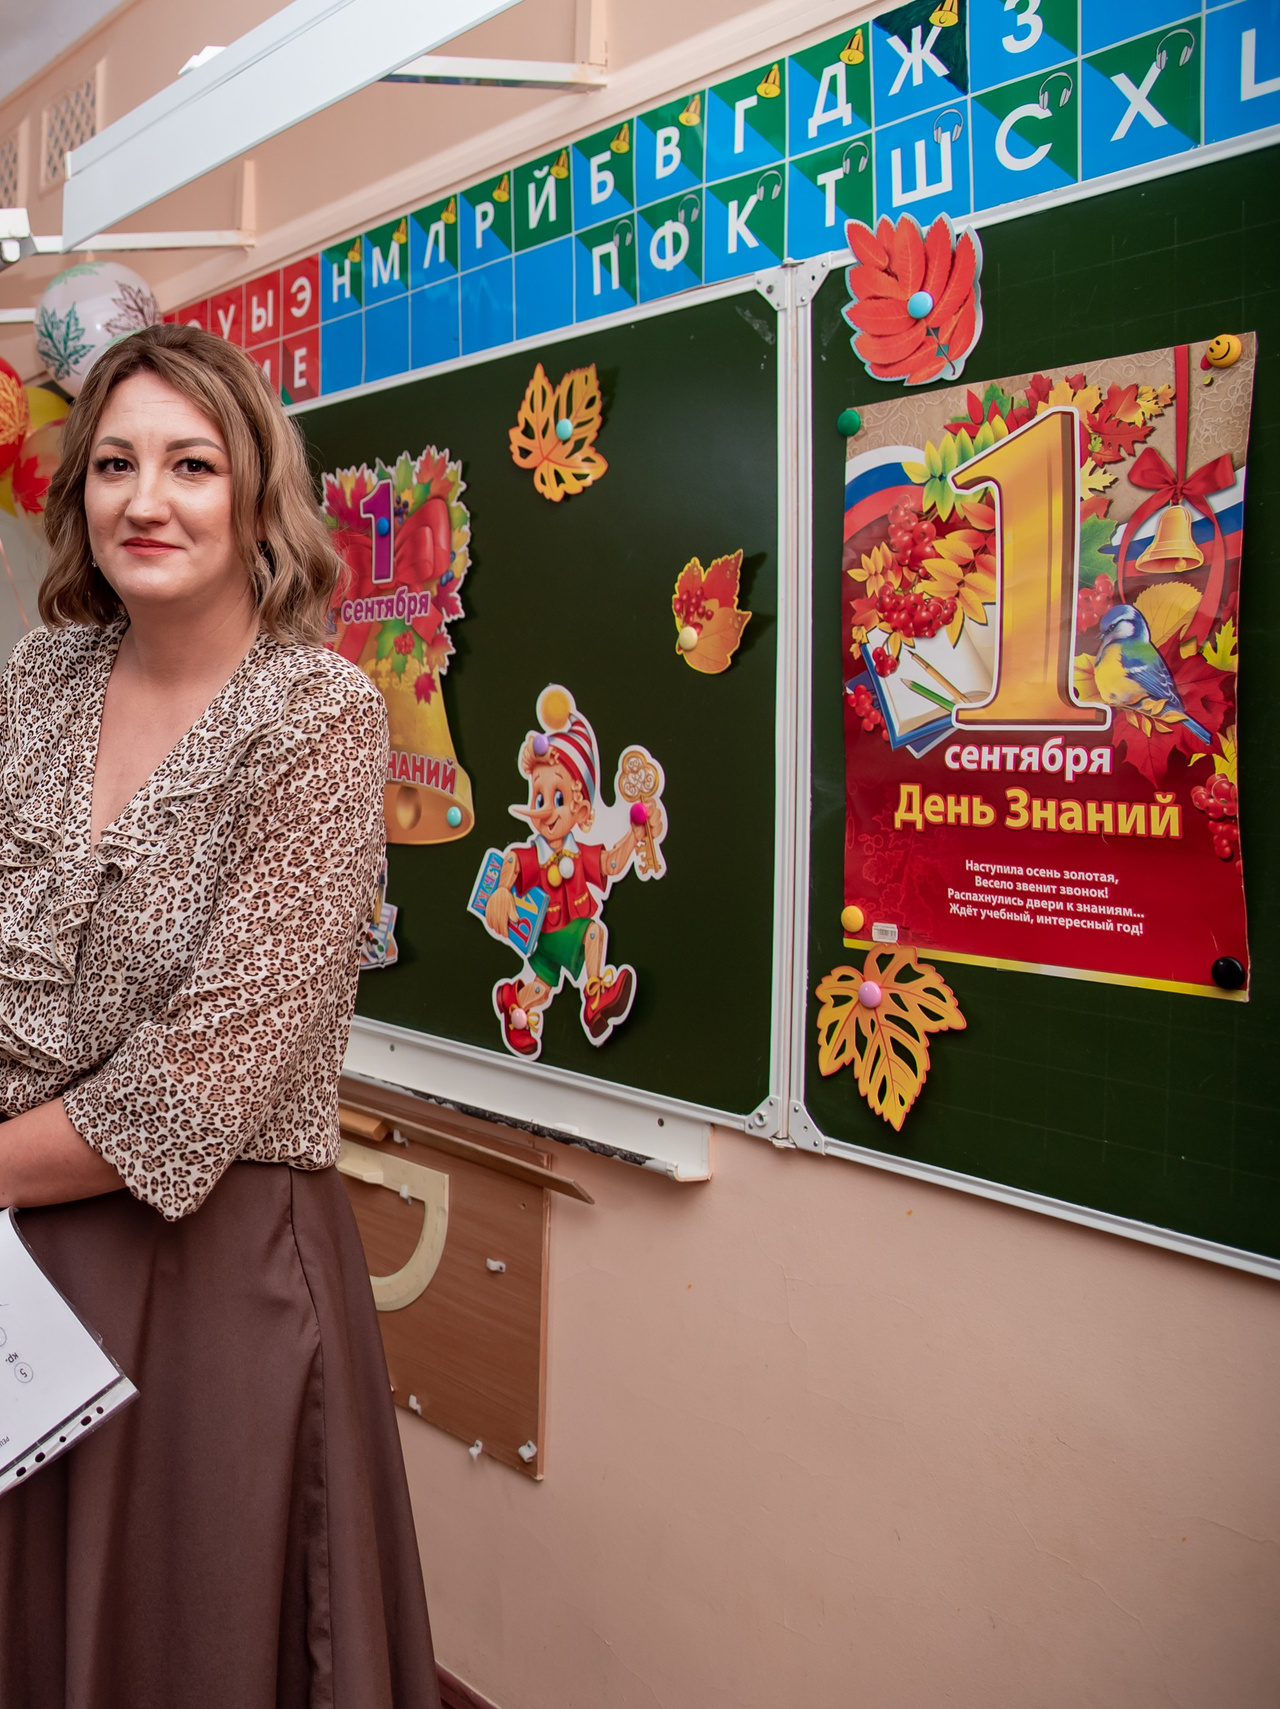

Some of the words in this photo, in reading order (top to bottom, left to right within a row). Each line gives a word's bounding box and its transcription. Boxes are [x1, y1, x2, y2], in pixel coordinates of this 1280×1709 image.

[886, 25, 950, 96] Ж
[734, 94, 758, 154] Г
[808, 61, 852, 139] Д
[1110, 61, 1169, 142] Х
[655, 126, 682, 180] В
[995, 103, 1053, 171] С
[590, 150, 615, 205] Б
[891, 131, 953, 208] Ш
[527, 165, 557, 230] Й
[817, 167, 845, 227] Т
[423, 220, 446, 269] Л
[475, 201, 495, 249] Р
[649, 220, 690, 271] Ф
[728, 194, 760, 254] К
[332, 258, 351, 303] Н
[372, 240, 400, 288] М
[592, 241, 620, 295] П
[251, 289, 274, 333] Ы
[290, 276, 312, 318] Э
[293, 346, 308, 389] Е
[361, 479, 394, 583] 1
[949, 405, 1112, 731] 1
[341, 586, 431, 625] сентября
[384, 750, 456, 795] НАНИЙ
[945, 736, 1113, 782] сентября
[894, 784, 995, 831] День
[1004, 787, 1182, 838] Знаний
[965, 859, 1024, 876] Наступила
[1026, 867, 1061, 879] осень
[1063, 870, 1119, 885] золотая,
[974, 875, 1014, 890] Весело
[1015, 881, 1057, 894] звенит
[1059, 886, 1109, 899] звонок!
[947, 887, 1024, 907] Распахнулись
[1025, 898, 1064, 912] двери
[1066, 901, 1074, 911] к
[949, 902, 979, 917] Ждёт
[979, 908, 1034, 924] учебный,
[1036, 914, 1114, 931] интересный
[1116, 922, 1144, 936] год!
